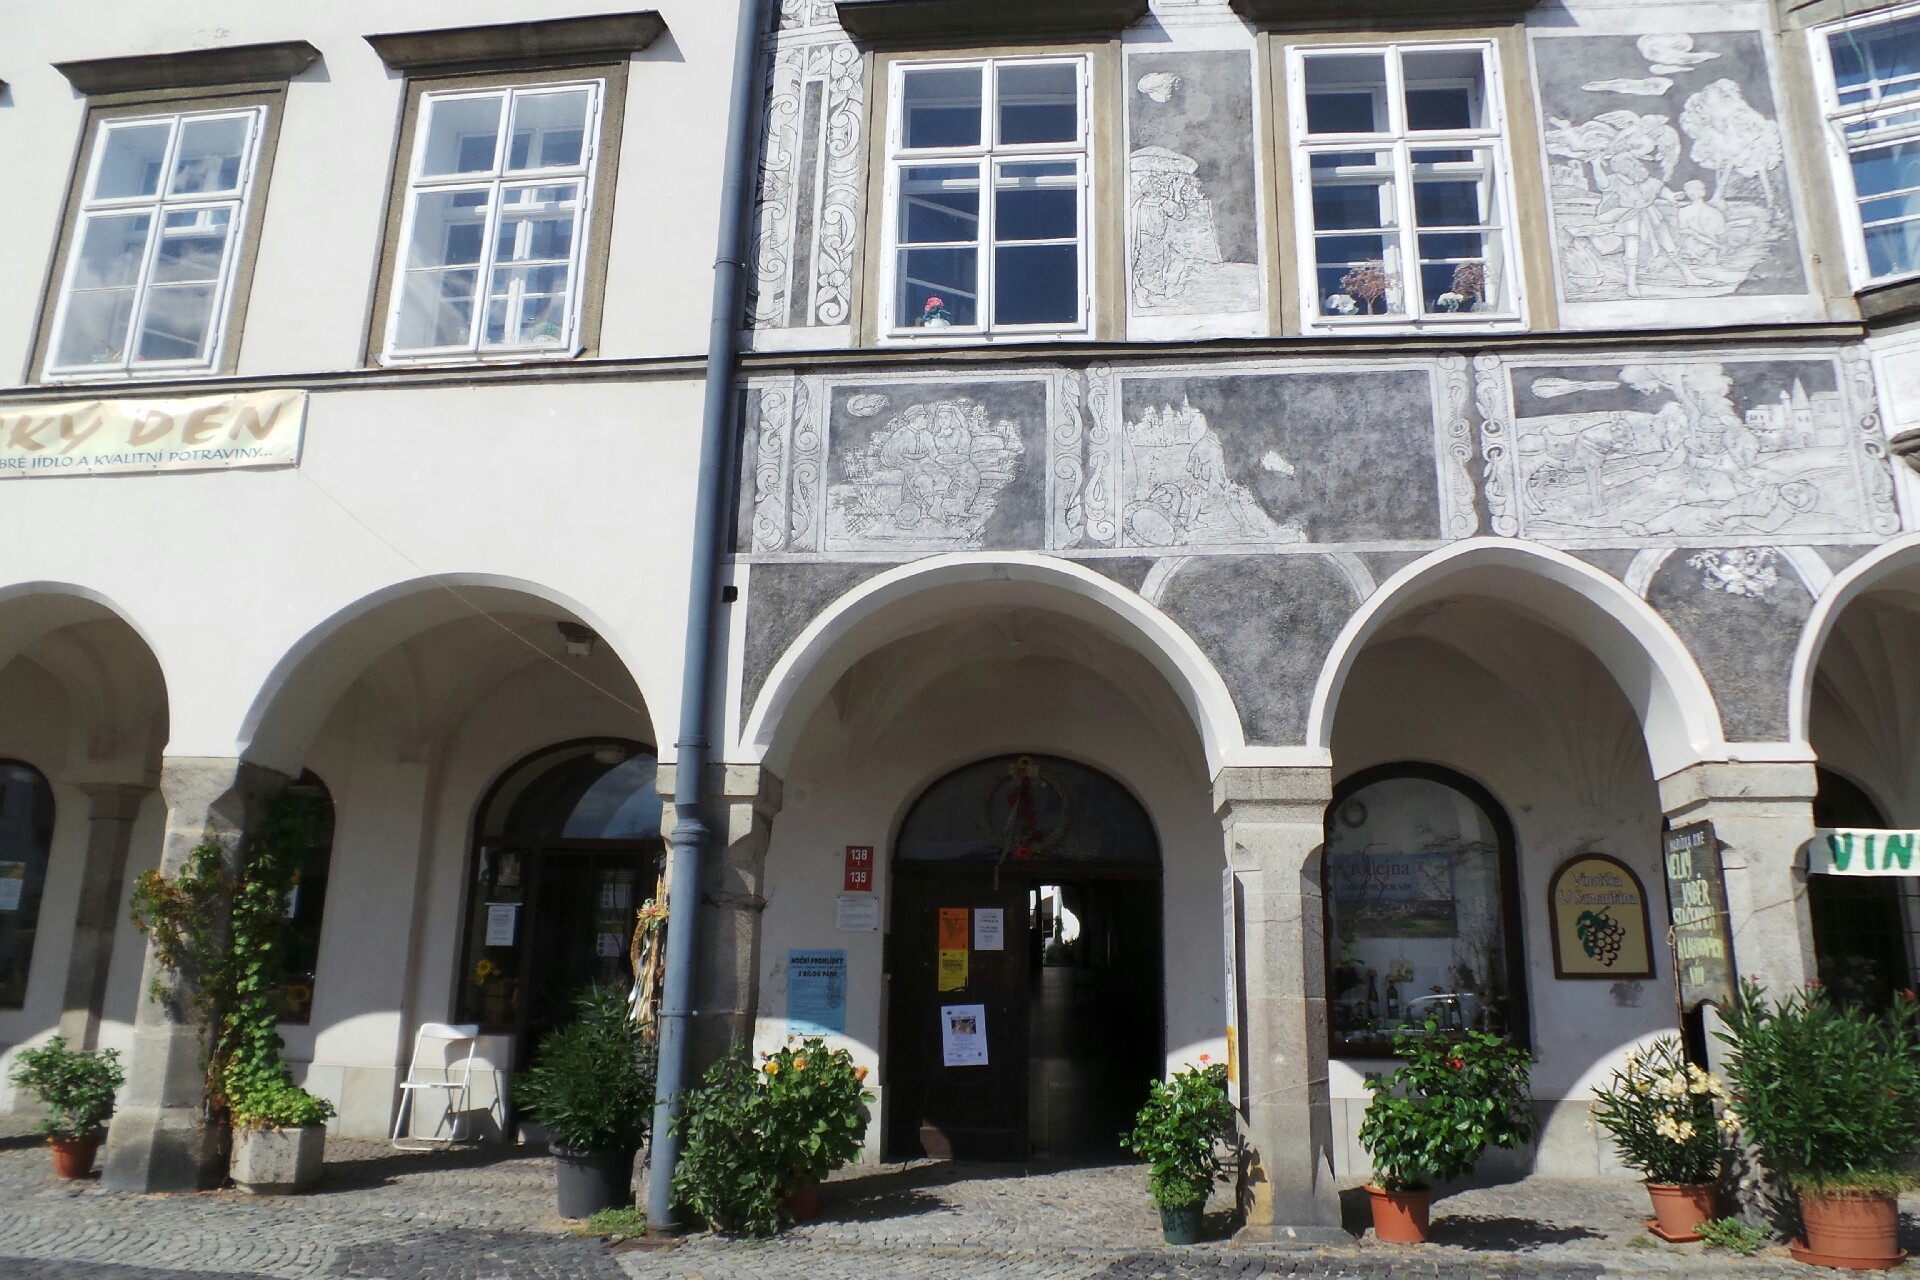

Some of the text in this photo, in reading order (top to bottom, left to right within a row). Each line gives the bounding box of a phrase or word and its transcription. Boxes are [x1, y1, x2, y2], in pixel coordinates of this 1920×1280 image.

[0, 401, 282, 455] KÝ DEN
[32, 455, 73, 469] JÍDLO
[76, 456, 89, 466] A
[94, 450, 163, 465] KVALITNÍ
[851, 849, 868, 860] 138
[1827, 832, 1920, 871] VIN
[850, 871, 867, 883] 139
[1559, 889, 1572, 904] U
[791, 956, 844, 965] NOČNÍ PROHLÍDKY
